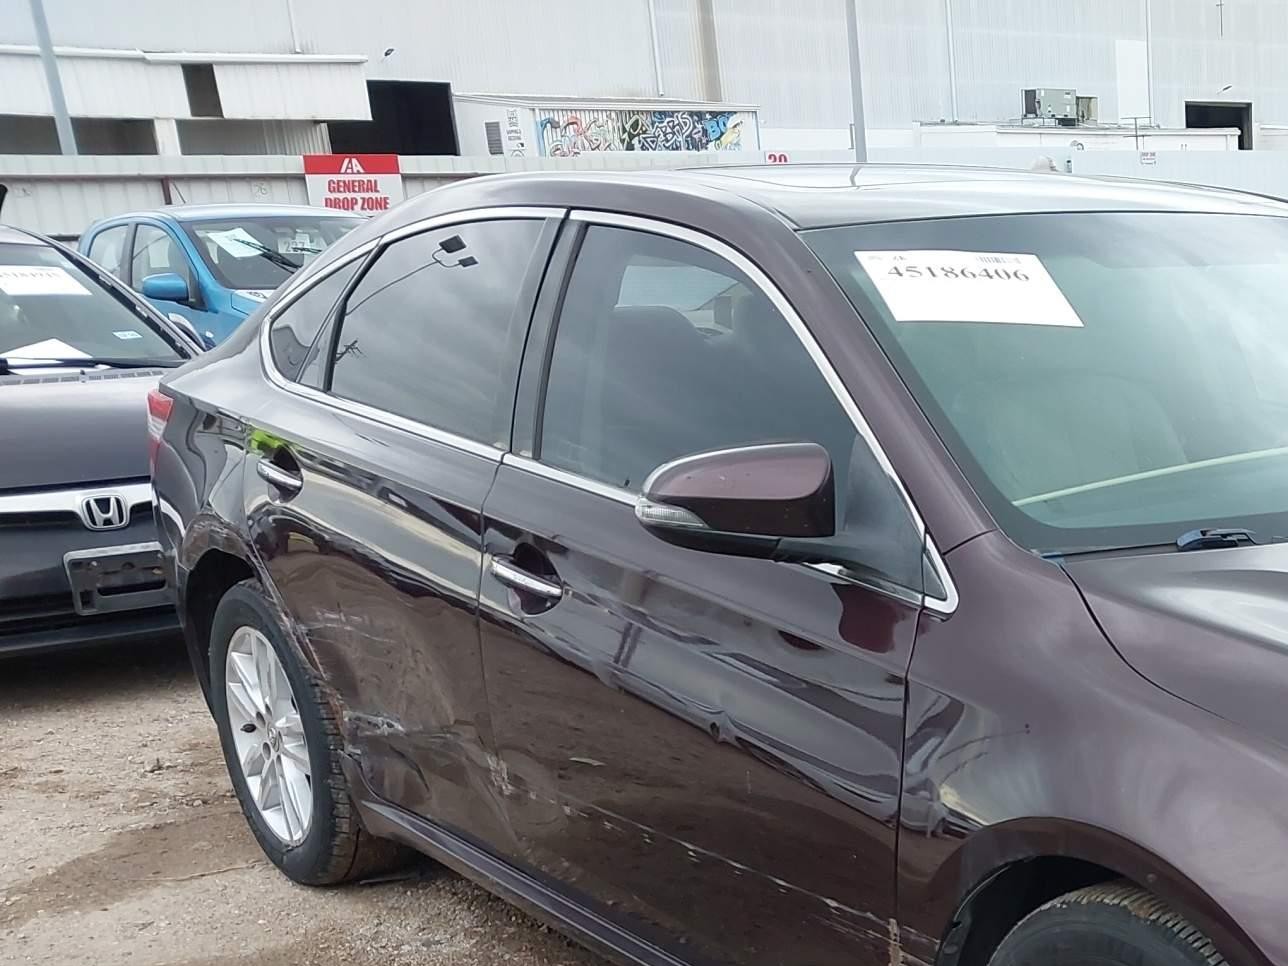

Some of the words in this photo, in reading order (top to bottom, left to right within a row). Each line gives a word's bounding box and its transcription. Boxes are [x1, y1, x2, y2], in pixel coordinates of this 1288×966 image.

[327, 179, 380, 194] GENERAL
[324, 196, 358, 211] DROP
[359, 196, 390, 211] ZONE
[887, 265, 1030, 282] 45186406
